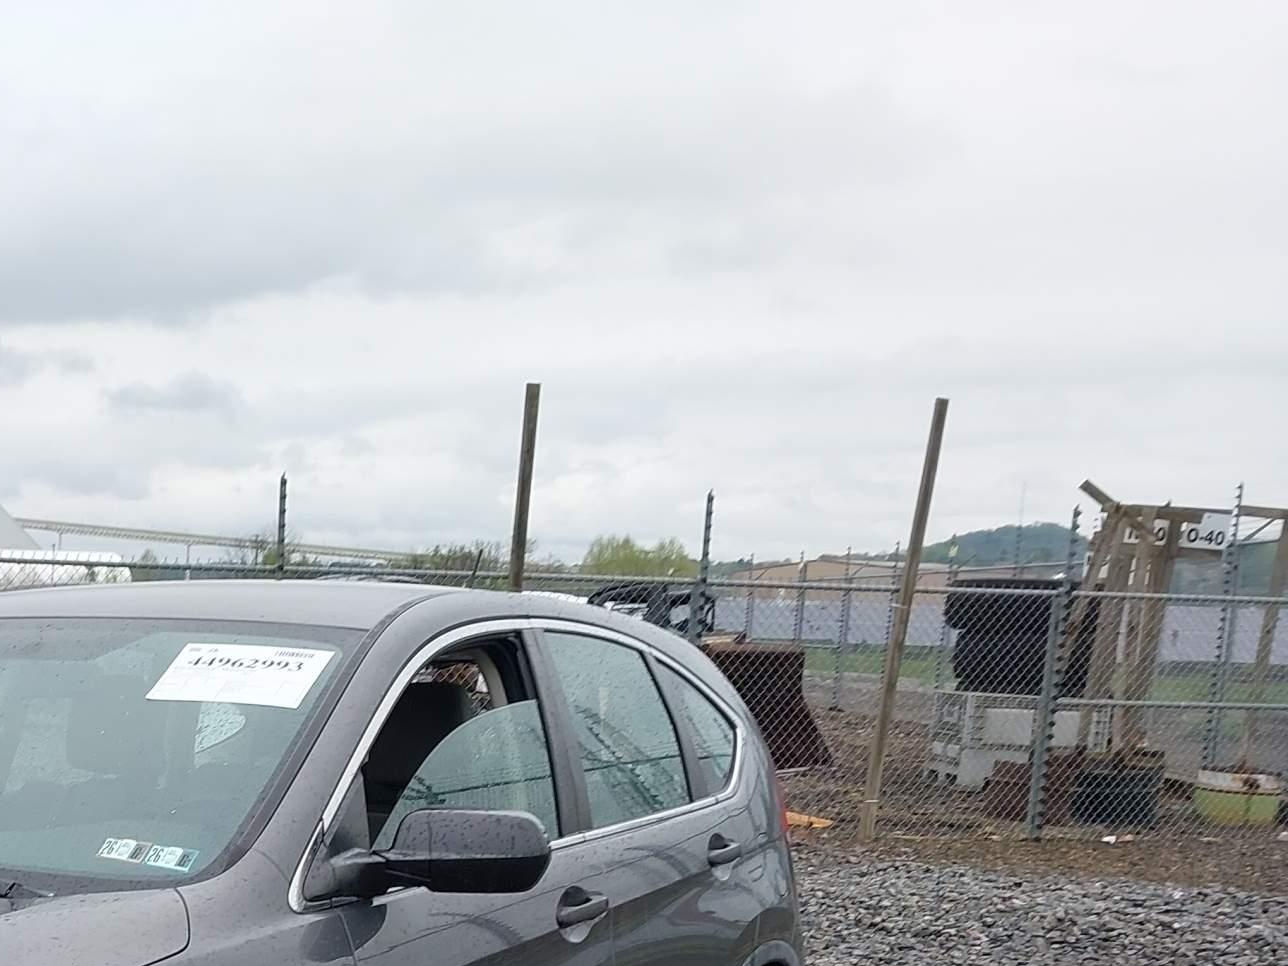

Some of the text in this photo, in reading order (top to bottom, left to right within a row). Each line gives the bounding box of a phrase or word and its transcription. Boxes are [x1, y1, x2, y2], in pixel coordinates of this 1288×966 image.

[187, 655, 305, 672] 44962993
[101, 839, 119, 855] 26
[147, 847, 165, 863] 26
